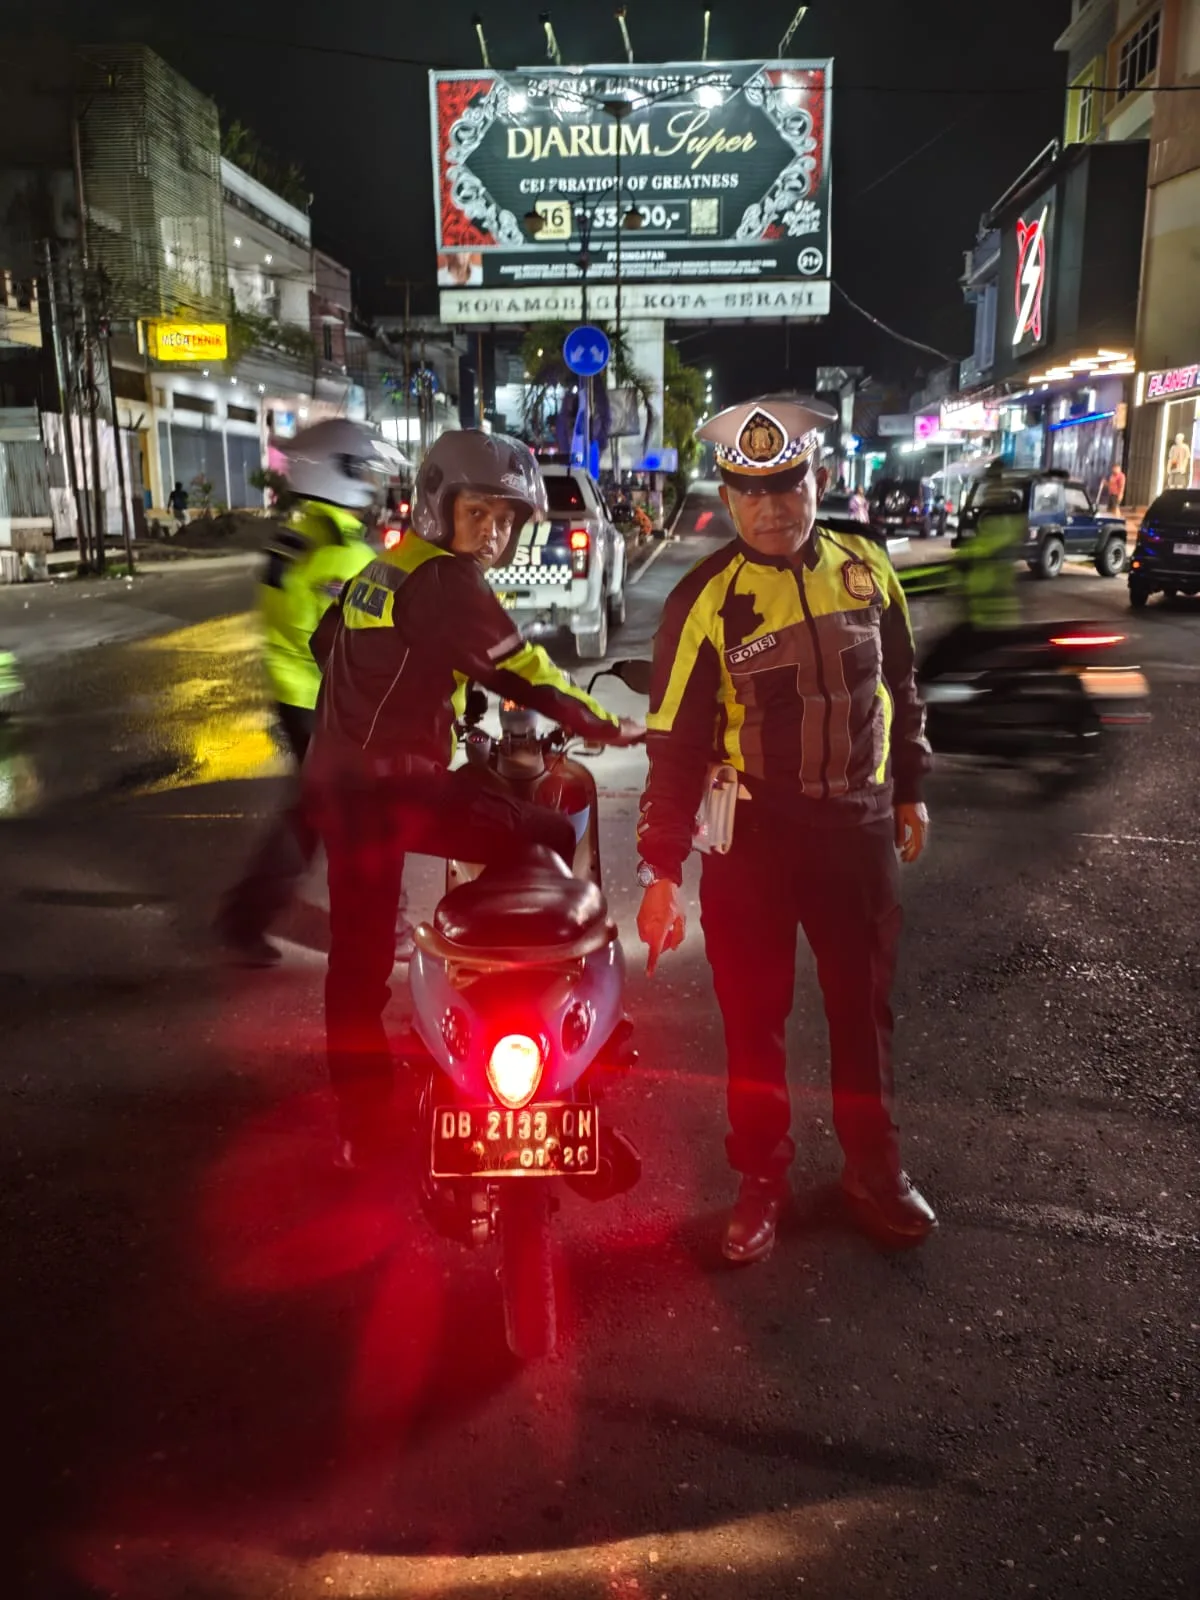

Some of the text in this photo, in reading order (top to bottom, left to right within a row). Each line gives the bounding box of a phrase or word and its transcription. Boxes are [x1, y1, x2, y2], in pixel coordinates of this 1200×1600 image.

[507, 110, 757, 170] DJARUM Super
[627, 176, 649, 191] OF
[651, 173, 739, 190] GREATNESS
[541, 207, 564, 227] 16
[643, 294, 708, 309] KOTA
[1148, 364, 1198, 397] PLANET
[730, 634, 775, 664] POLISI
[440, 1111, 471, 1139] DB
